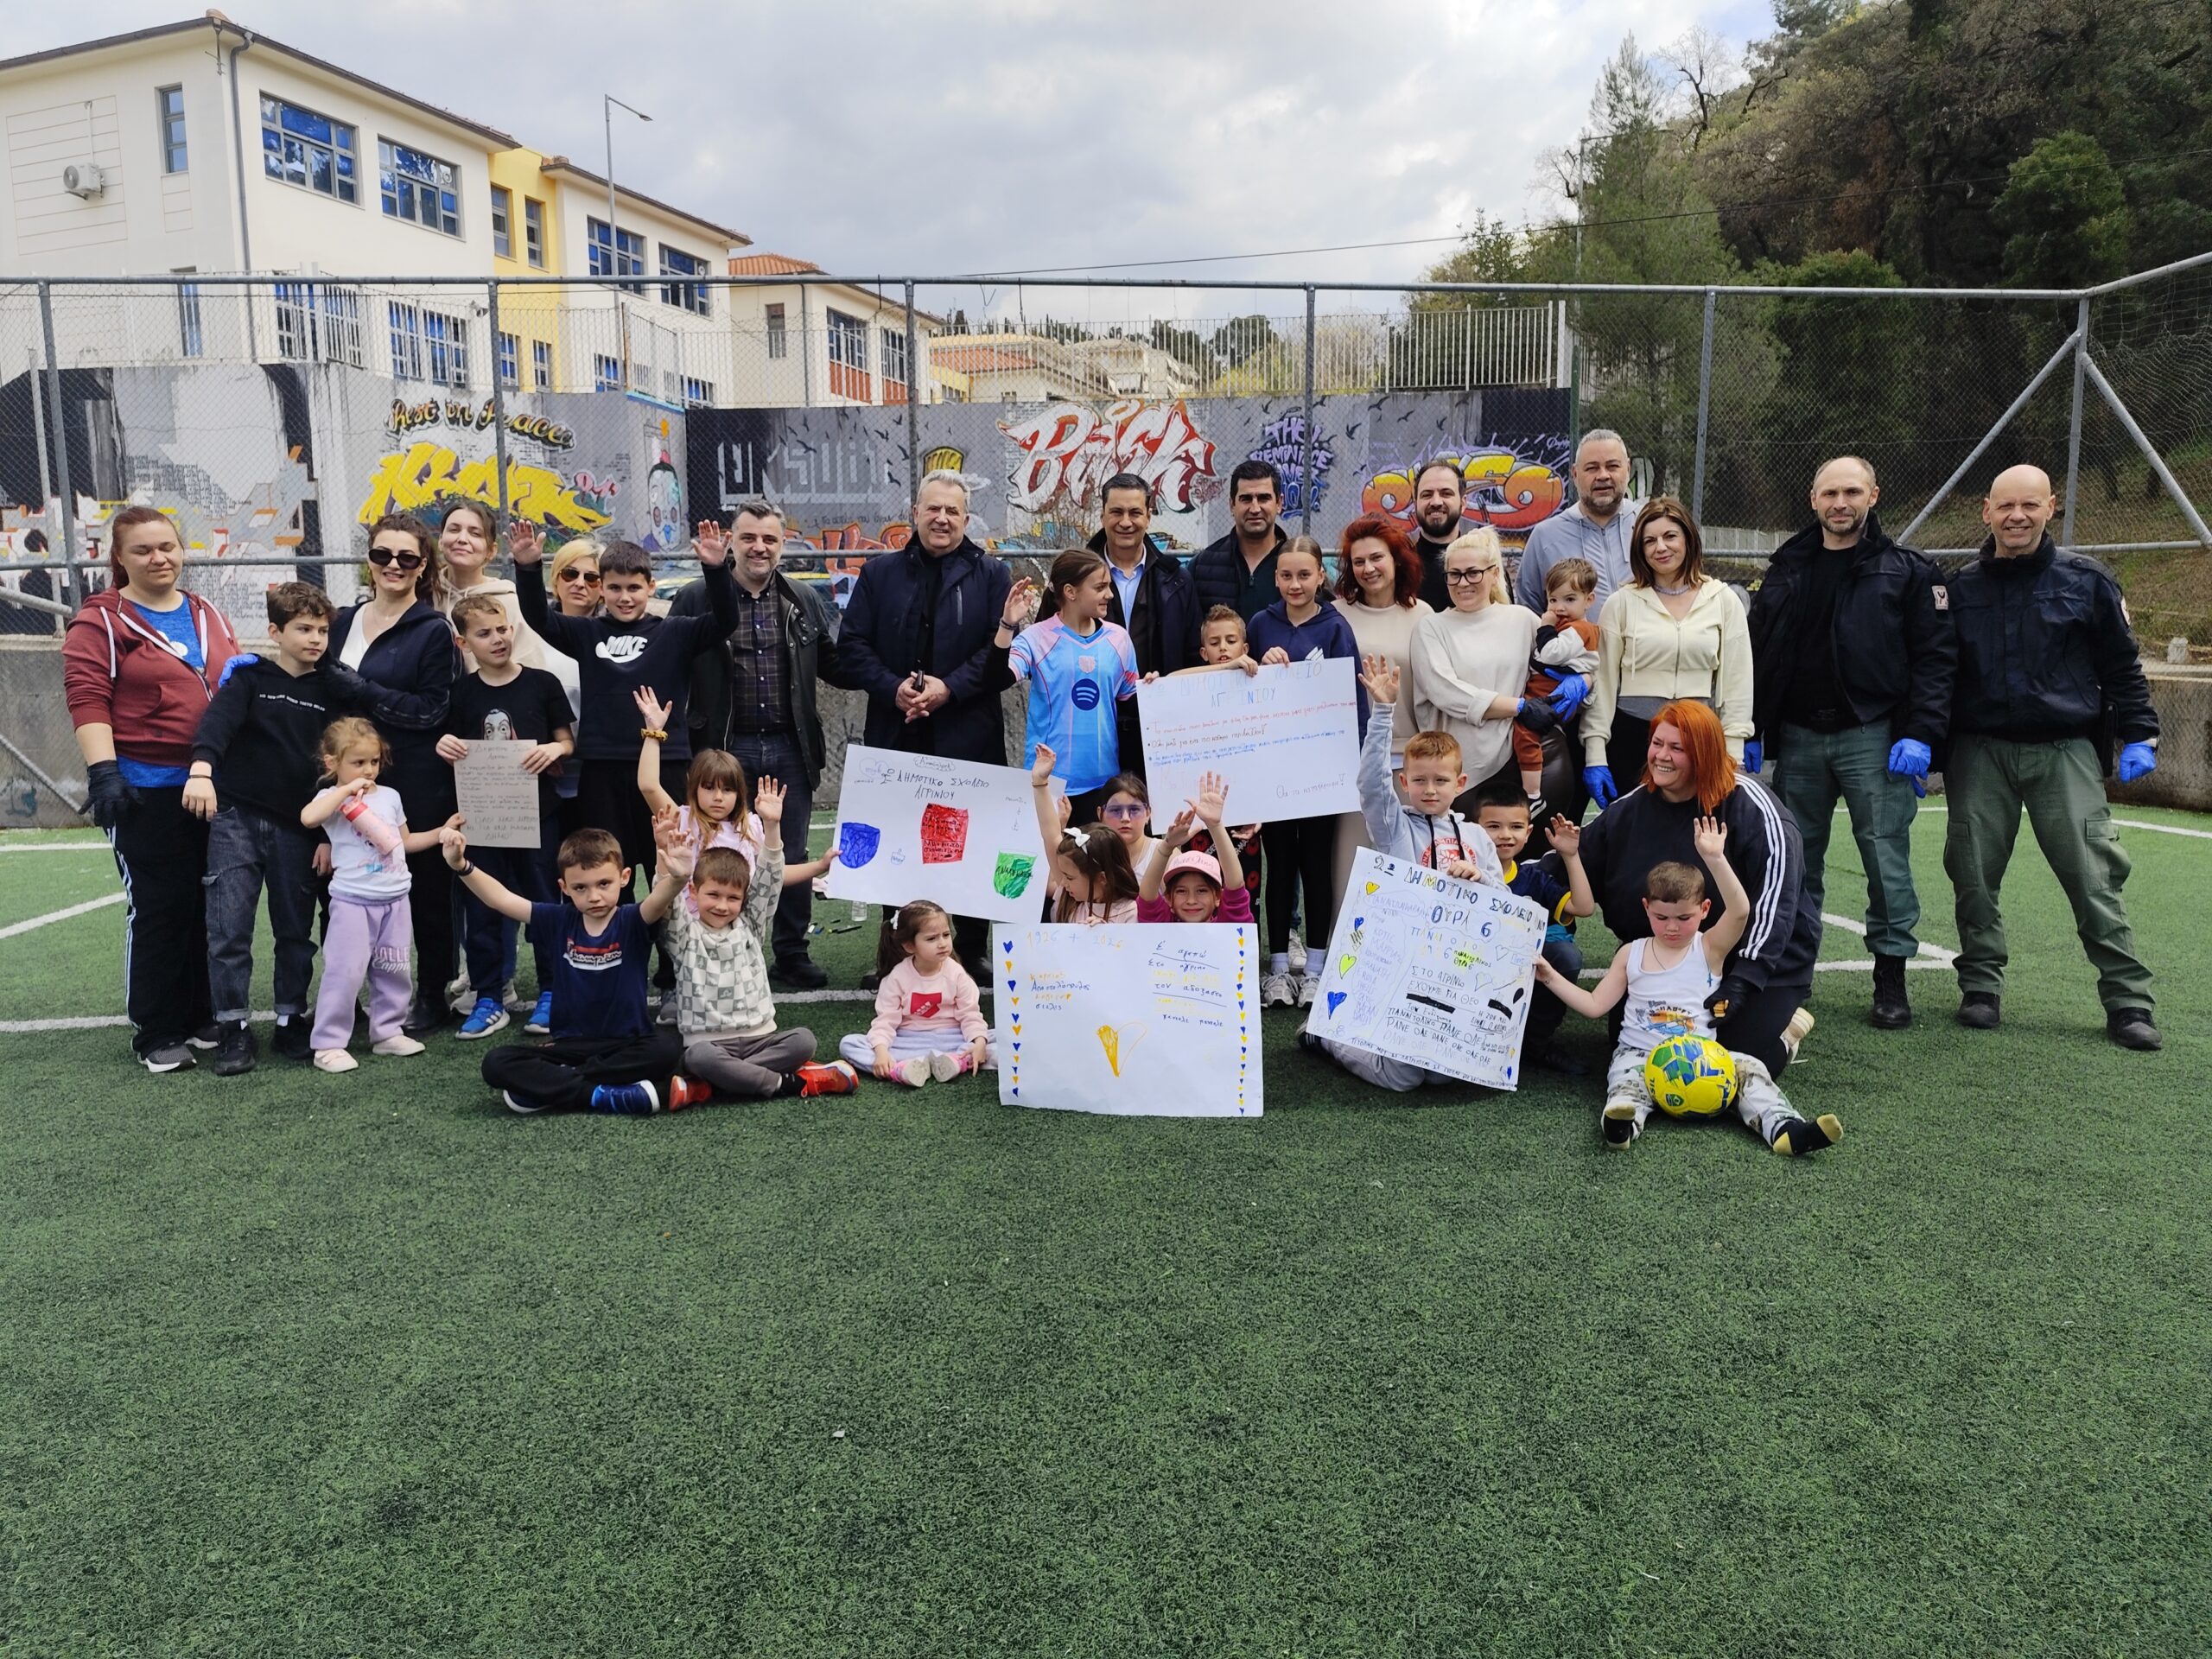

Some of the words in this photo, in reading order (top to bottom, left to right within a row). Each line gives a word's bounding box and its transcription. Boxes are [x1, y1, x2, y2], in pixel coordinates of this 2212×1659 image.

[606, 635, 648, 656] NIKE
[896, 769, 944, 786] ΔΗΜΟΤΙΚΟ
[1404, 867, 1479, 905] ΔΗΜΟΤΙΚΟ
[1431, 905, 1471, 933] ΘΥΡΑ
[1480, 921, 1493, 938] 6
[1411, 965, 1433, 978] ΣΤΟ
